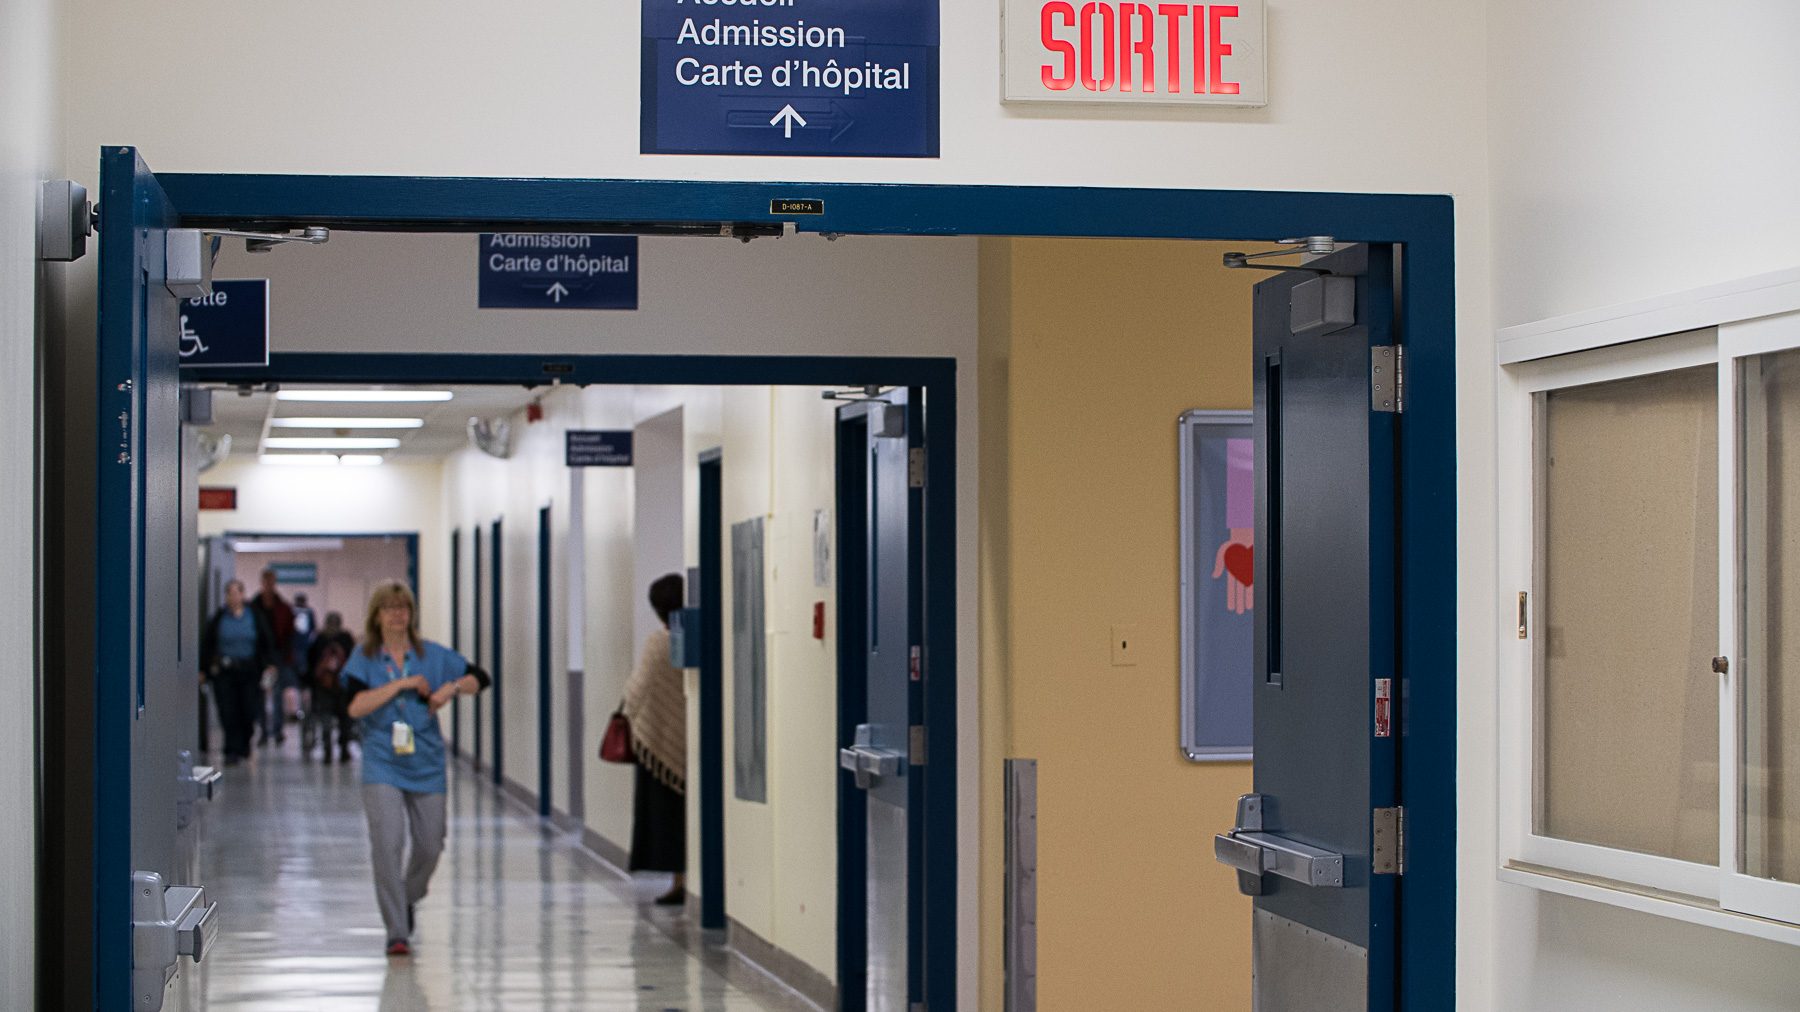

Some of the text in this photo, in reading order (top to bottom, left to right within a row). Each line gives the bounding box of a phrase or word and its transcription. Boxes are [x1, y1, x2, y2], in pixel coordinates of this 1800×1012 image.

[676, 18, 845, 48] Admission
[1041, 1, 1240, 94] SORTIE
[675, 57, 910, 95] Carte d’hôpital
[490, 233, 591, 249] Admission
[489, 253, 629, 276] Carte d’hôpital
